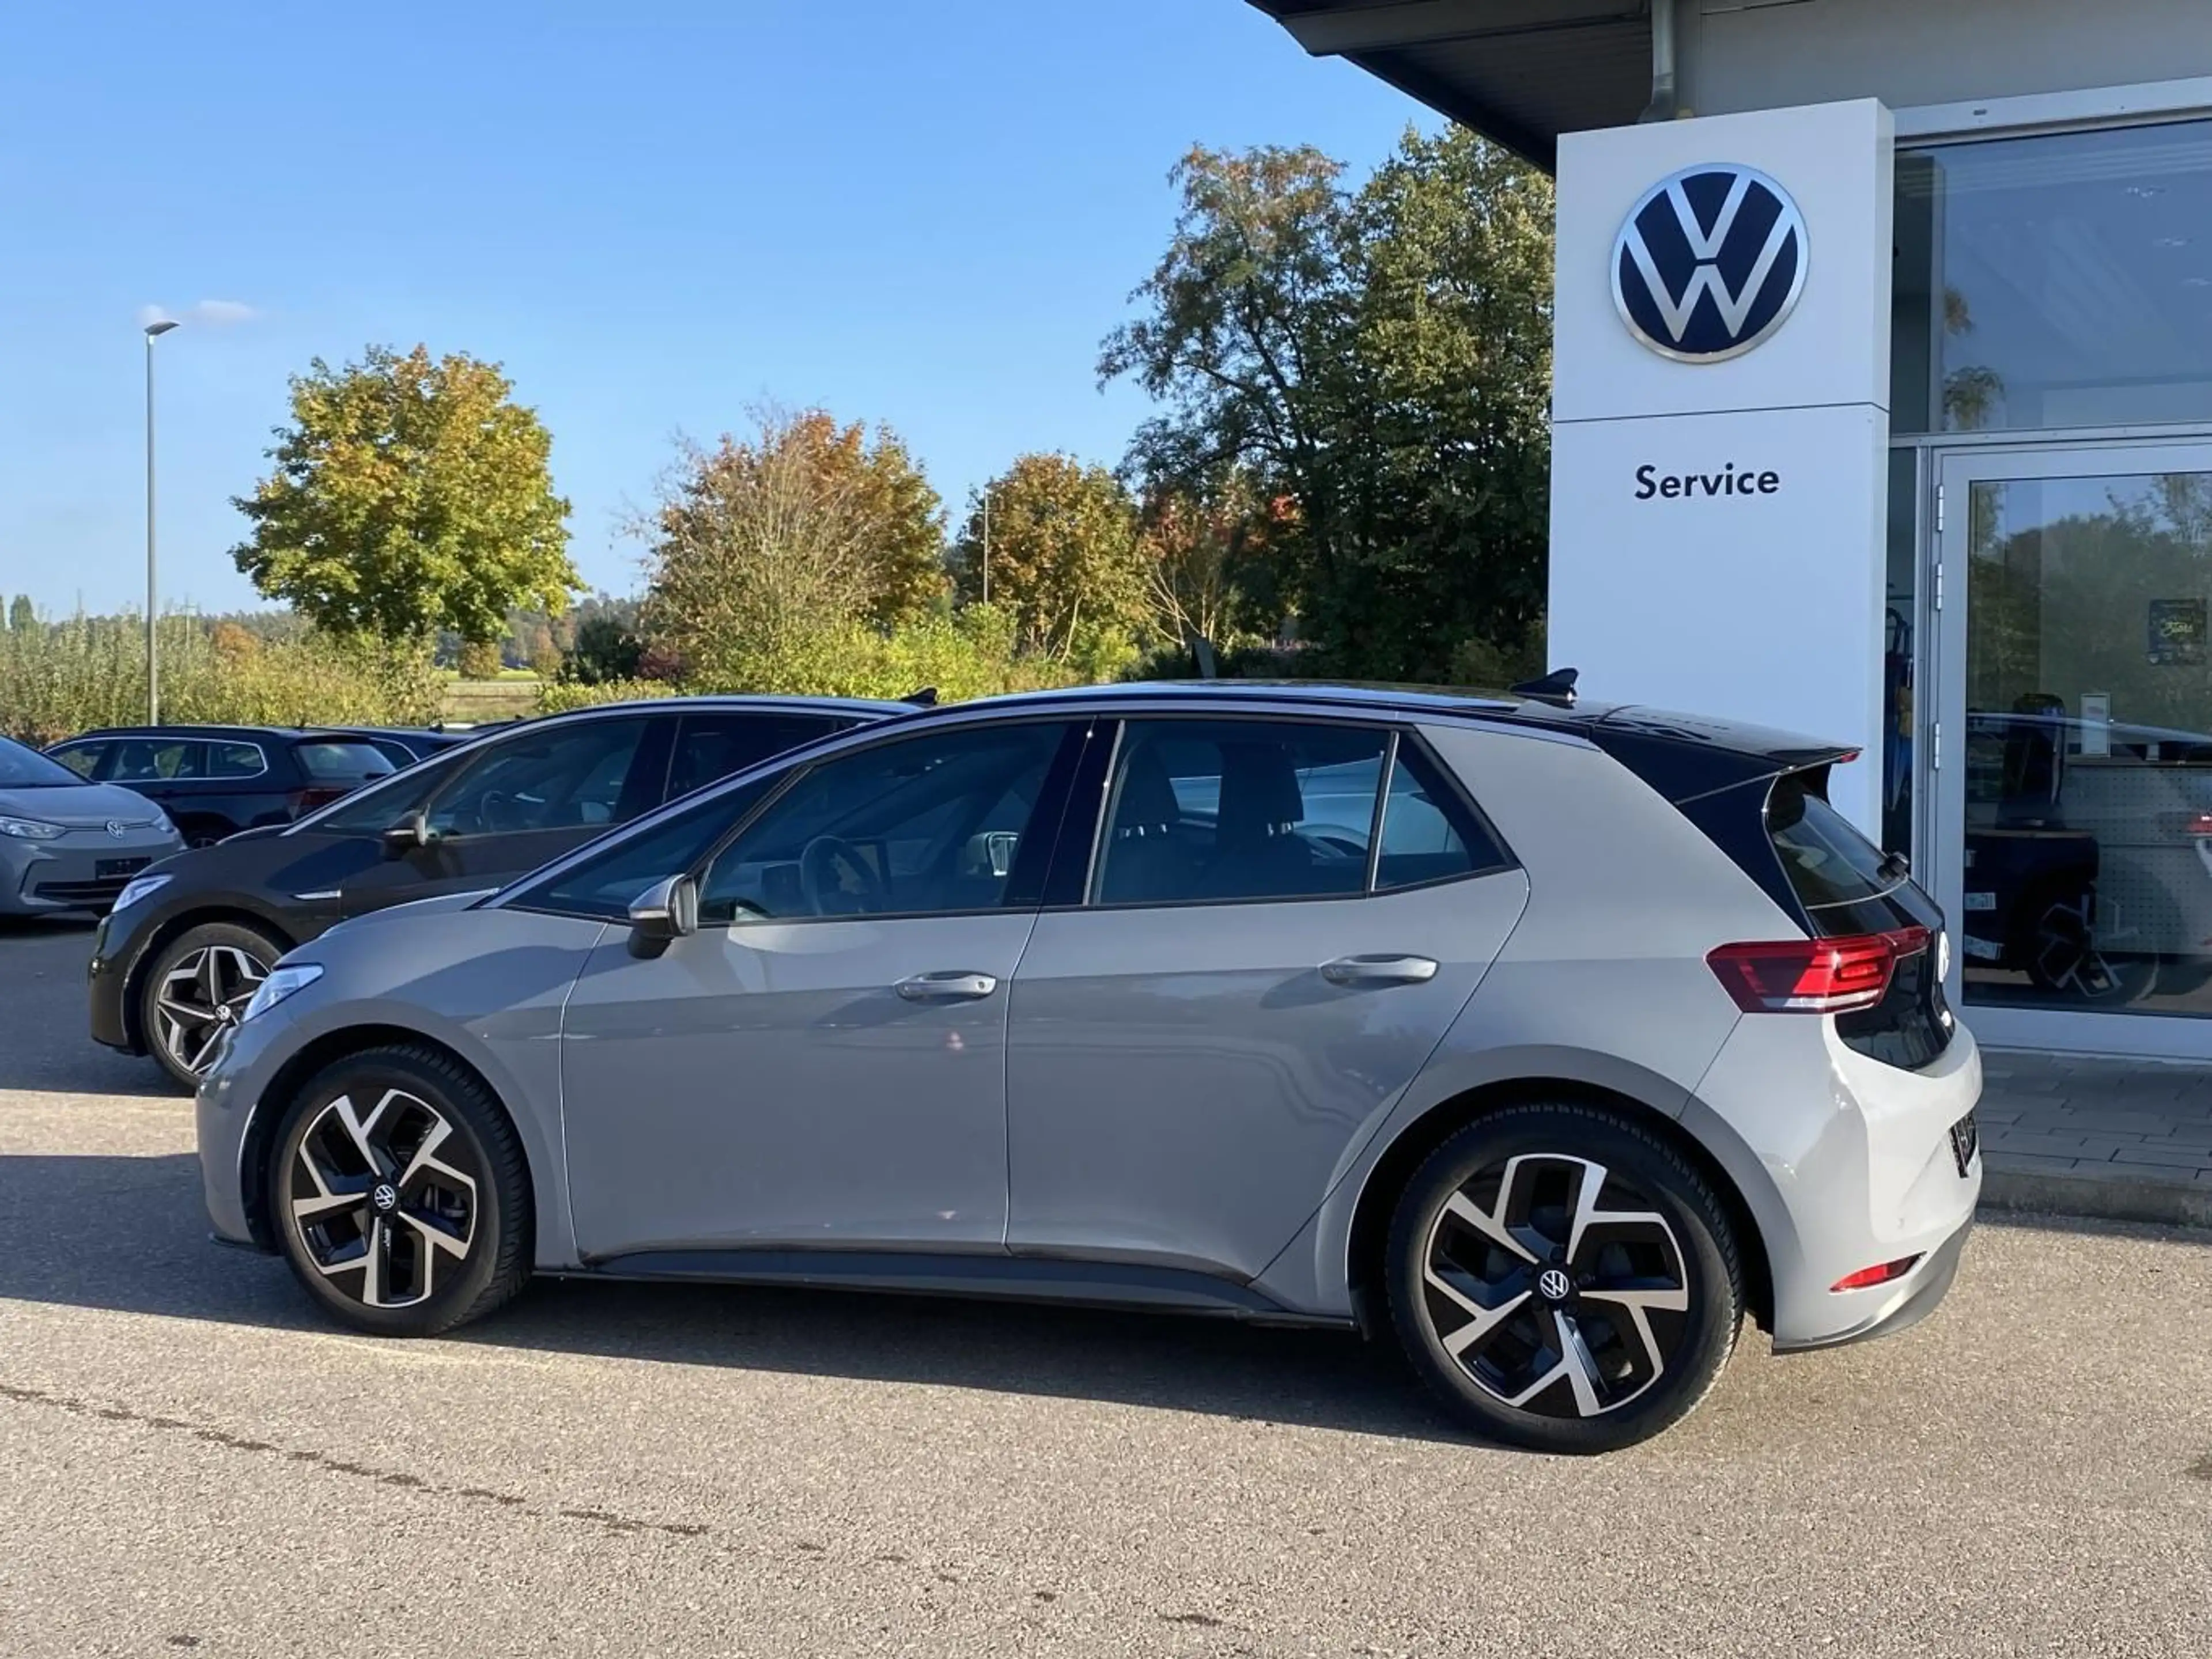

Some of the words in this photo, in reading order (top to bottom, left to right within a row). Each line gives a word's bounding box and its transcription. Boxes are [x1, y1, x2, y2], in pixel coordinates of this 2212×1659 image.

[1616, 168, 1803, 353] VW
[1635, 463, 1779, 499] Service
[1540, 1270, 1569, 1299] VW
